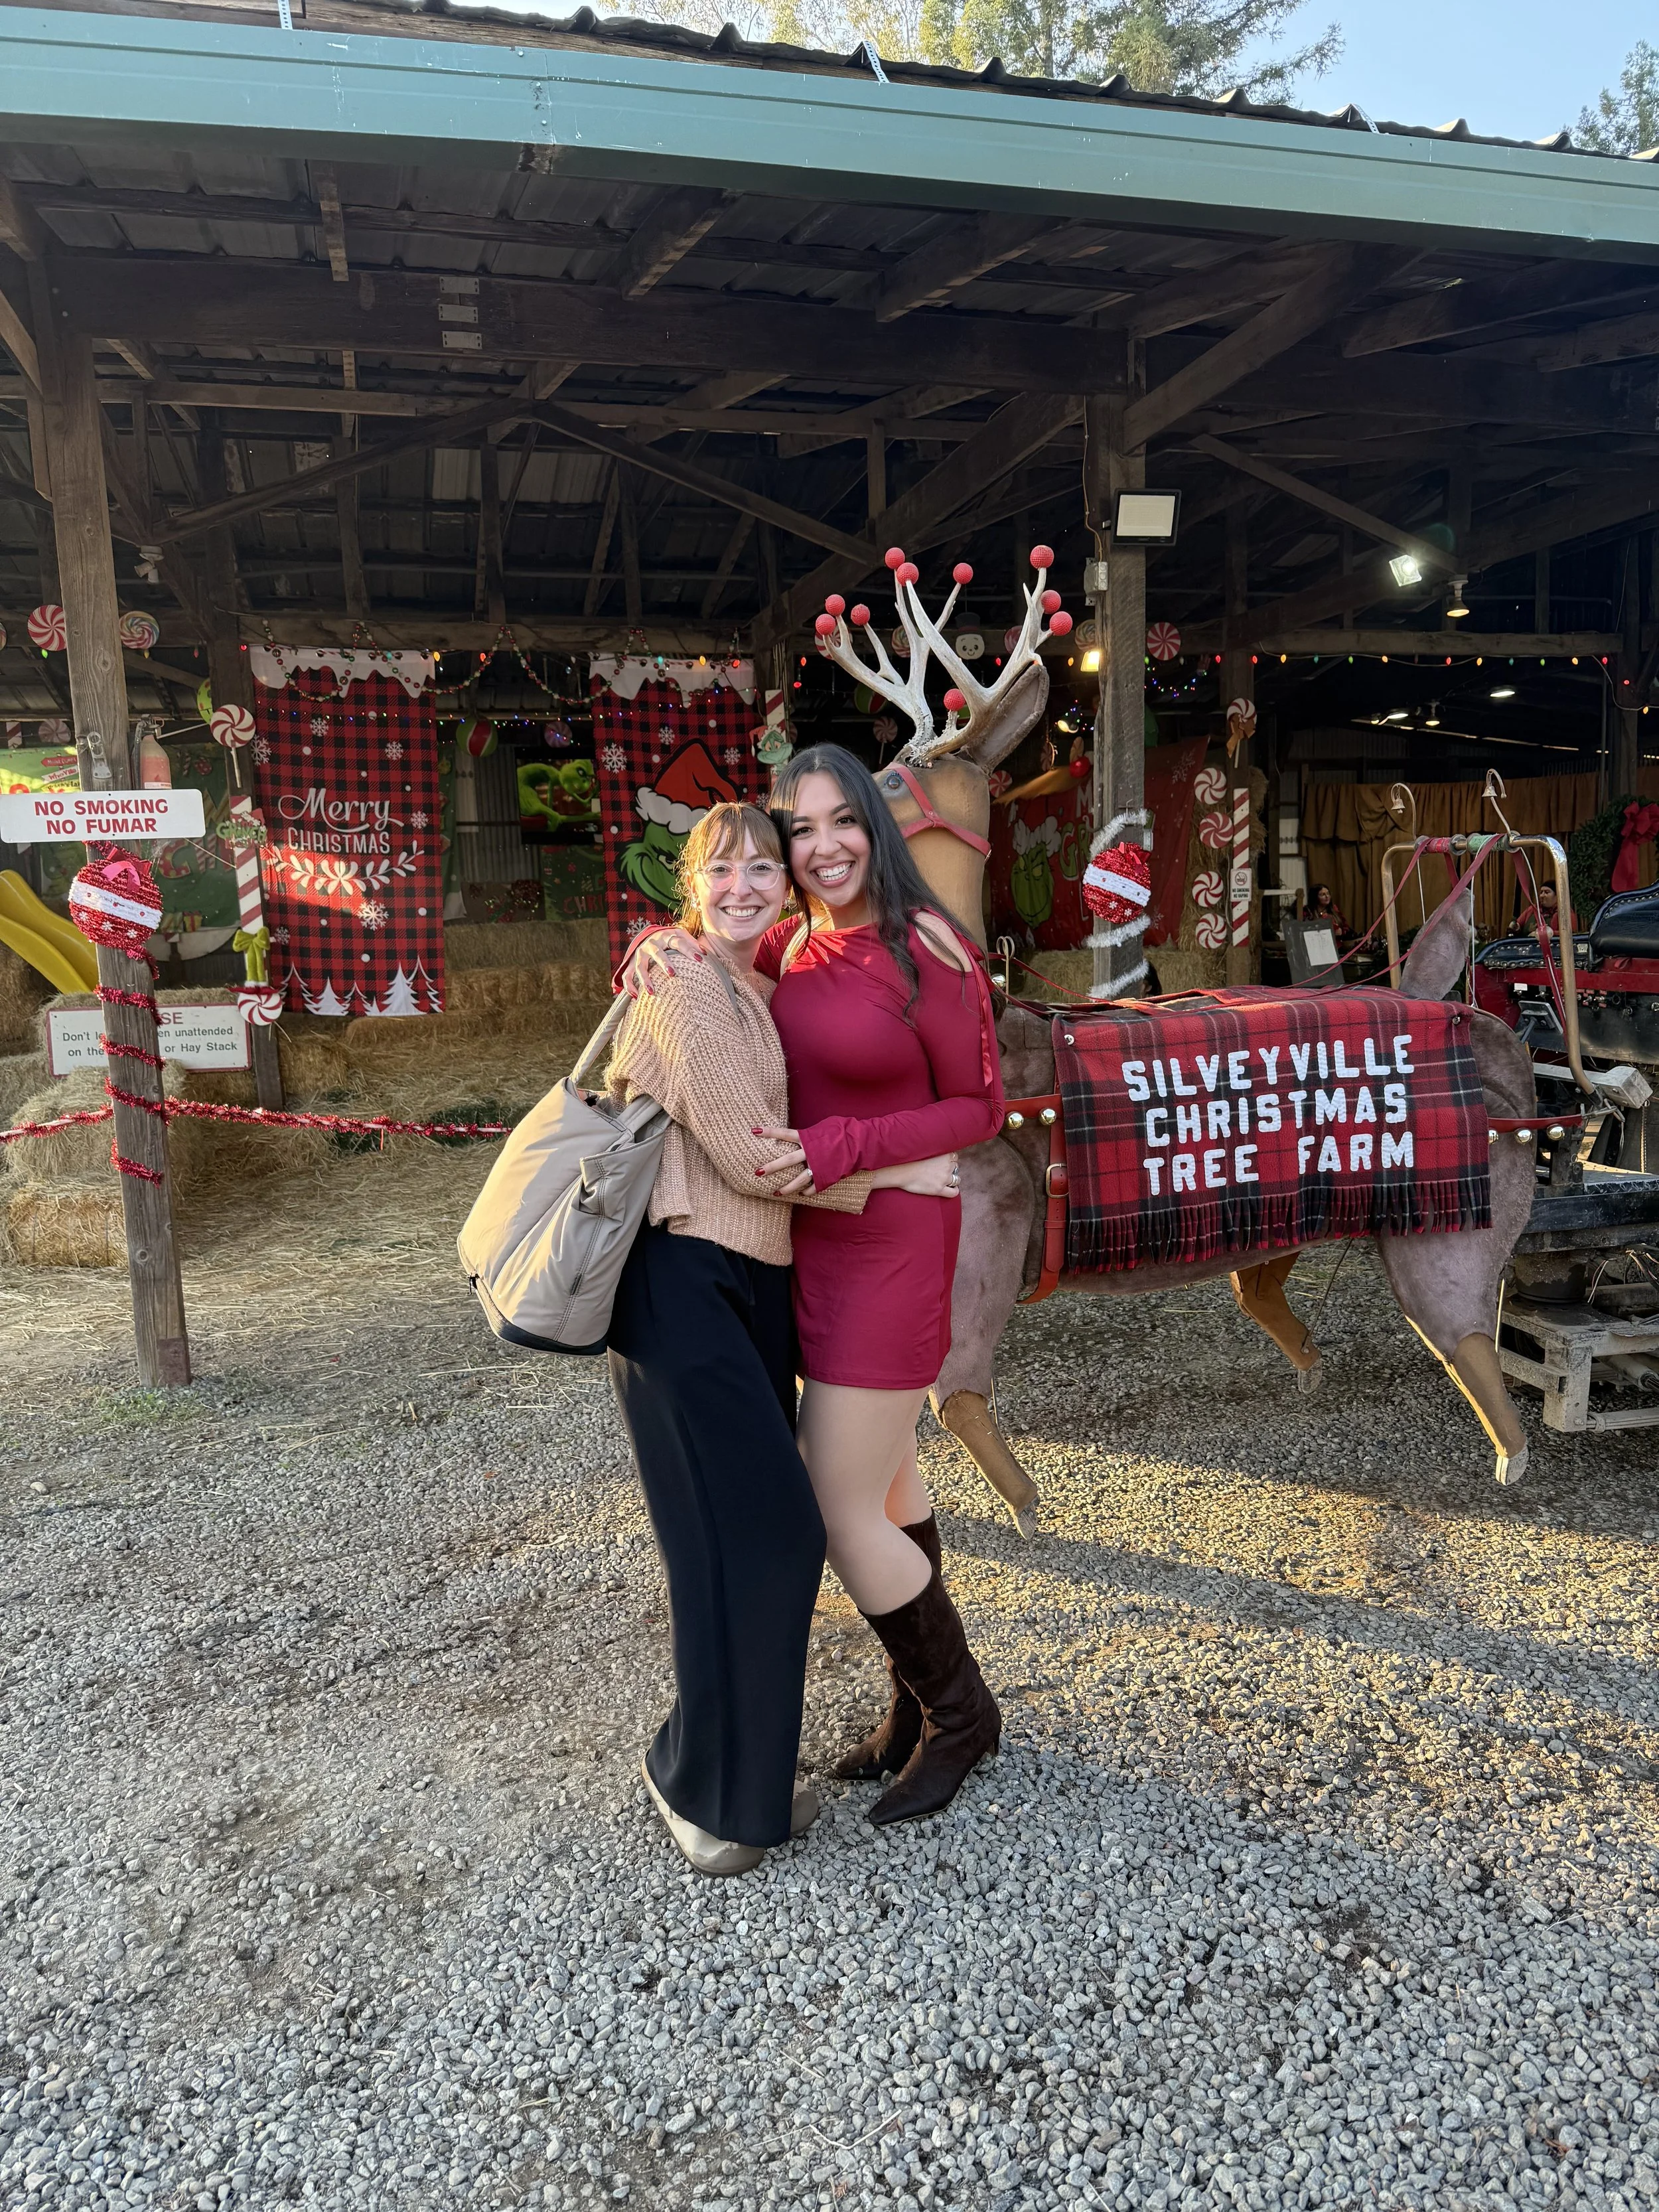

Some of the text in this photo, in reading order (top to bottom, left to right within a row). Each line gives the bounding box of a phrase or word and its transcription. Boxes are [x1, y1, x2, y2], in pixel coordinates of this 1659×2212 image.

[35, 799, 169, 816] NO SMOKING
[278, 788, 405, 833] Merry
[46, 818, 157, 834] NO FUMAR
[288, 827, 390, 854] CHRISTMAS
[62, 1032, 90, 1041] Don't
[175, 1026, 233, 1037] unattended
[87, 1047, 105, 1056] the
[180, 1043, 201, 1053] Hay
[206, 1041, 238, 1051] Stack
[1121, 1035, 1415, 1102] SILVEYVILLE
[1146, 1083, 1407, 1147] CHRISTMAS
[1143, 1132, 1413, 1196] TREE FARM
